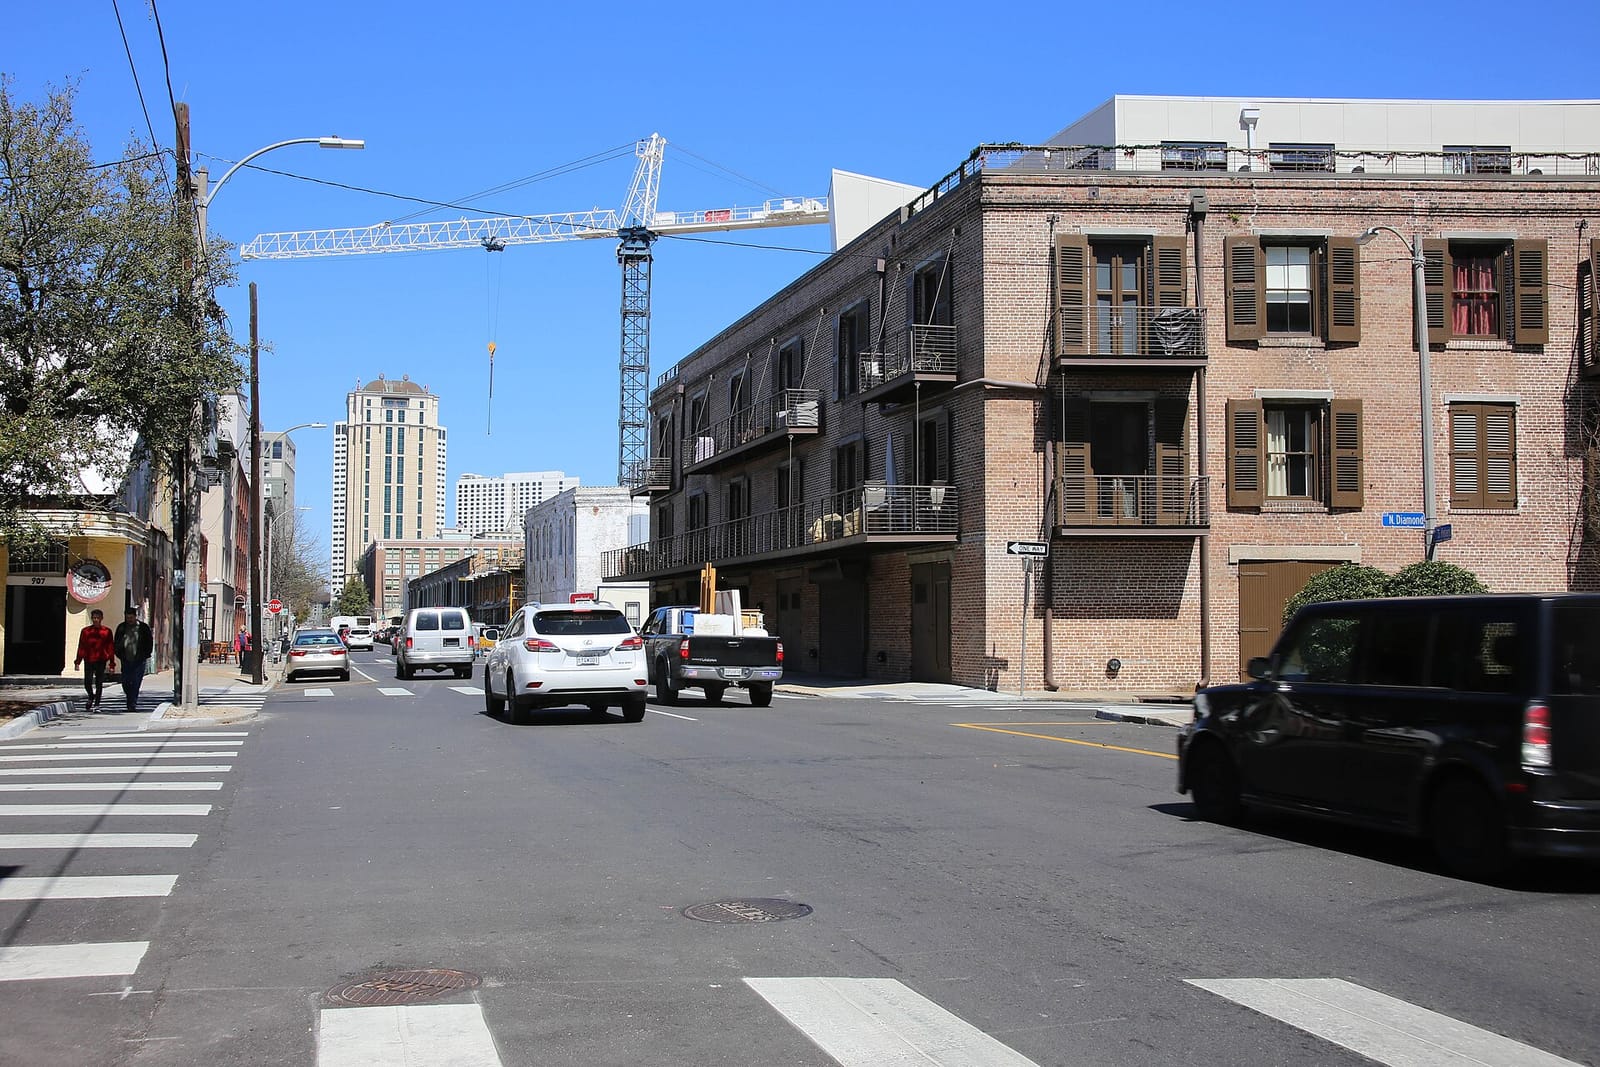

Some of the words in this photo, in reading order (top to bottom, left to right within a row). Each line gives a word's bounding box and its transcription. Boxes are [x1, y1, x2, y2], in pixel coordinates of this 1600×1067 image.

[1388, 514, 1395, 525] N.
[1396, 514, 1424, 525] Diamond
[31, 577, 45, 585] 907
